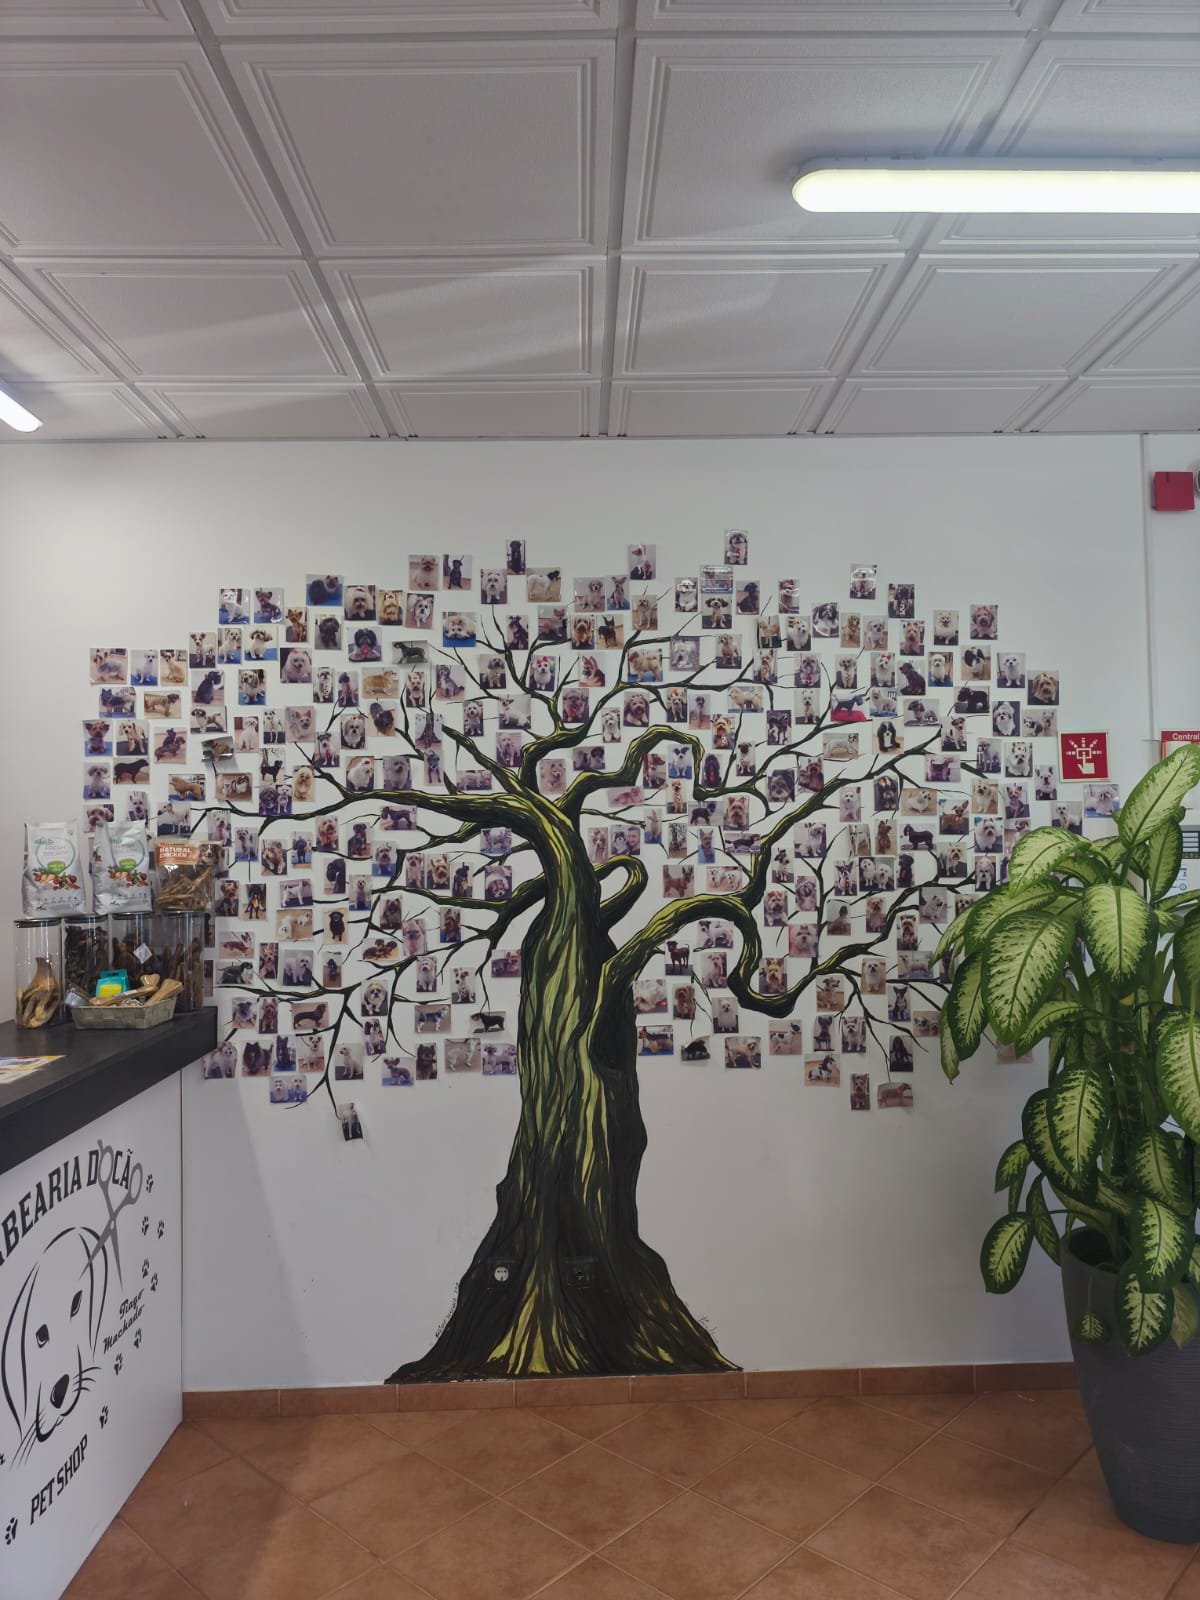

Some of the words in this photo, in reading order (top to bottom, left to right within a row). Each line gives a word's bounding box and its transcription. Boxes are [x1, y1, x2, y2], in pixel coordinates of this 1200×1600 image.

[1172, 732, 1200, 741] Central
[119, 1288, 144, 1320] Tiago
[103, 1304, 144, 1354] Machado
[30, 1477, 55, 1525] PET
[56, 1433, 88, 1496] SHOP
